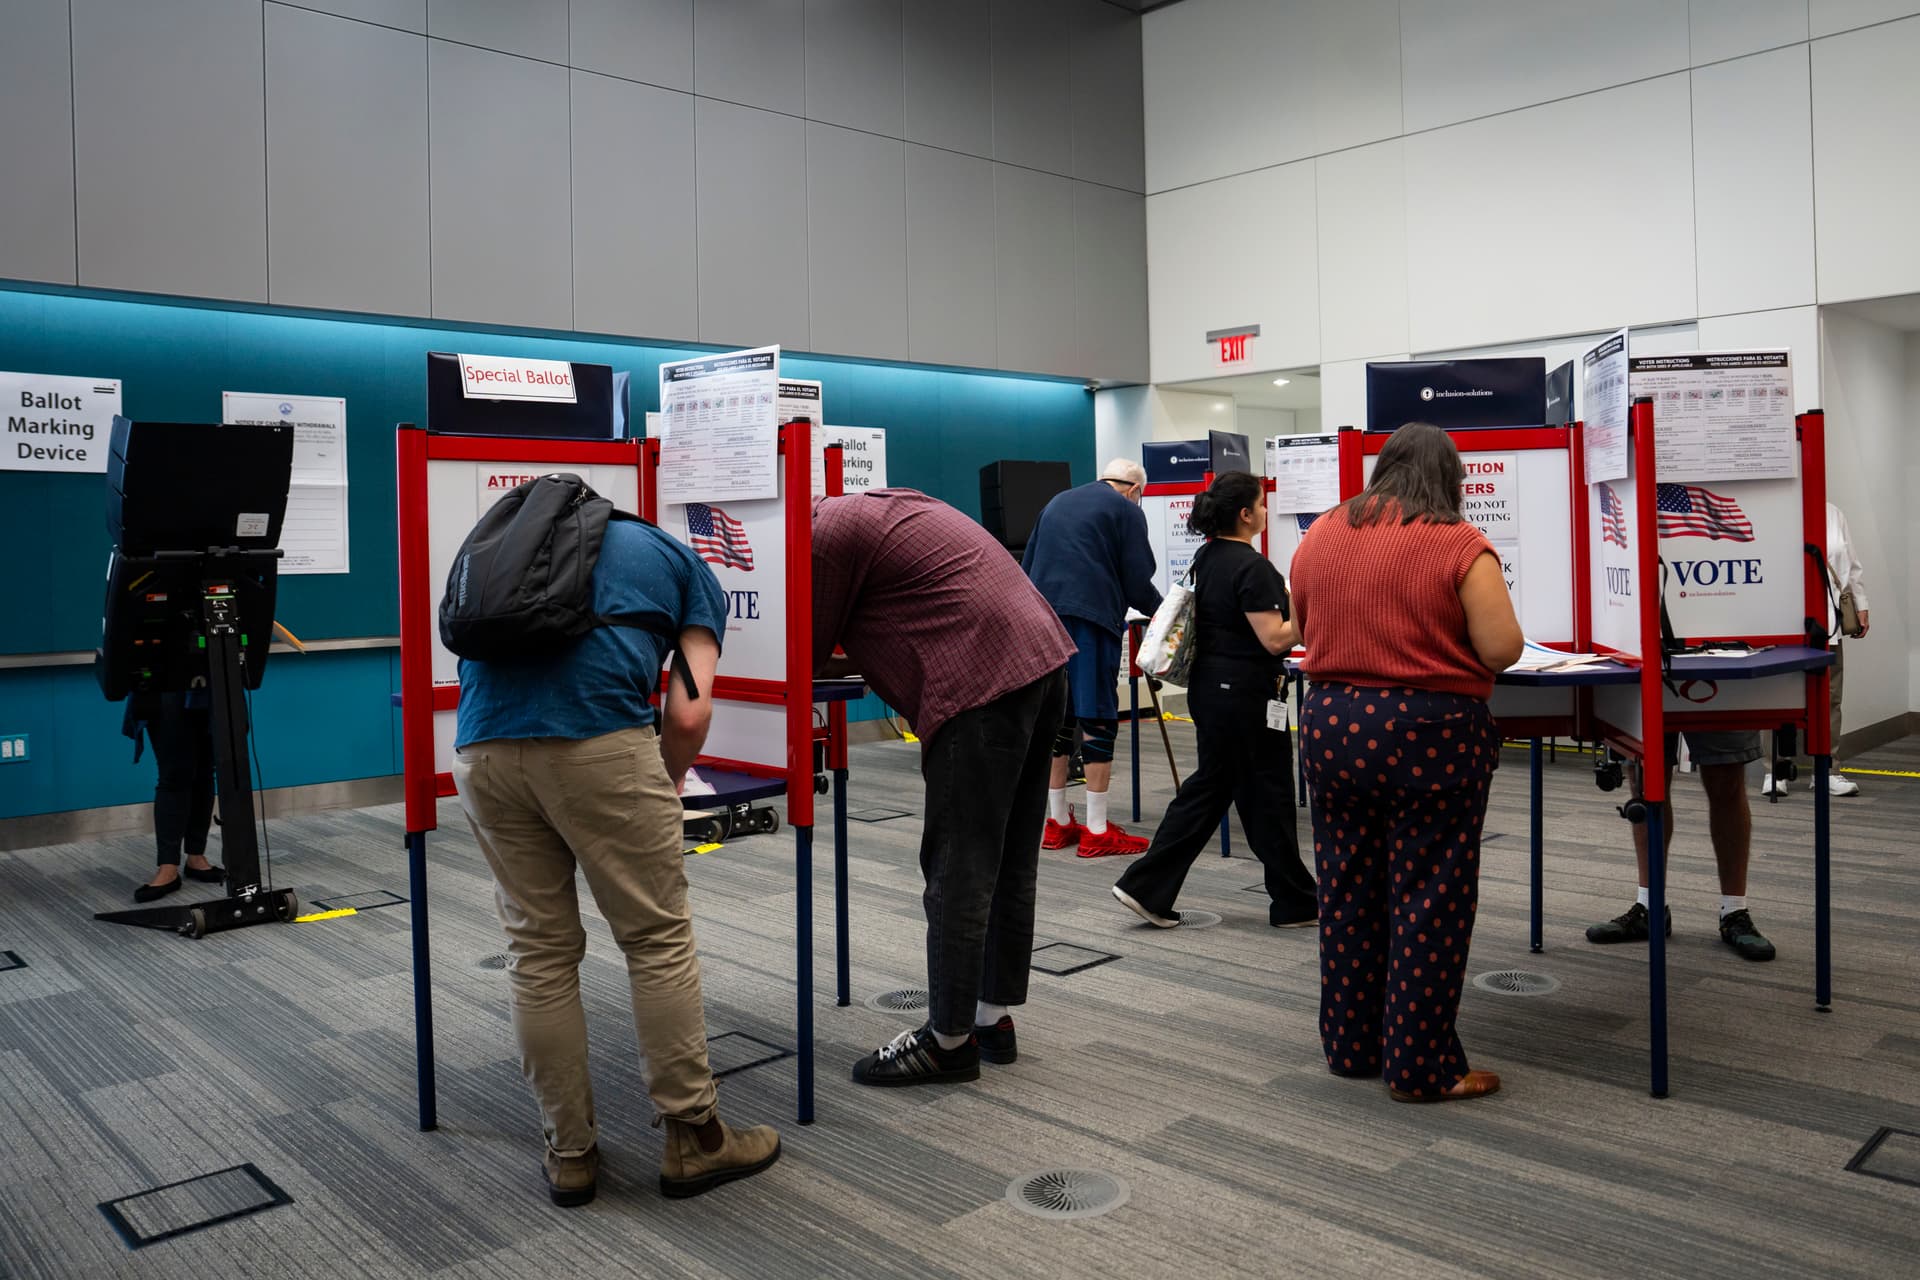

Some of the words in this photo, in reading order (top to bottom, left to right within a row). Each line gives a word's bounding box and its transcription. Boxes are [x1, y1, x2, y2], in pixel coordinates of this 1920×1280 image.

[1221, 336, 1245, 362] EXIT
[466, 366, 521, 384] Special
[526, 370, 570, 385] Ballot
[21, 391, 82, 410] Ballot
[8, 416, 94, 440] Marking
[17, 442, 87, 461] Device
[842, 457, 873, 471] arking
[844, 475, 869, 486] evice
[1466, 501, 1481, 510] DO
[1484, 500, 1507, 509] NOT
[1469, 513, 1511, 522] VOTING
[1606, 566, 1631, 597] VOTE
[1671, 559, 1764, 587] VOTE
[722, 590, 760, 620] TE
